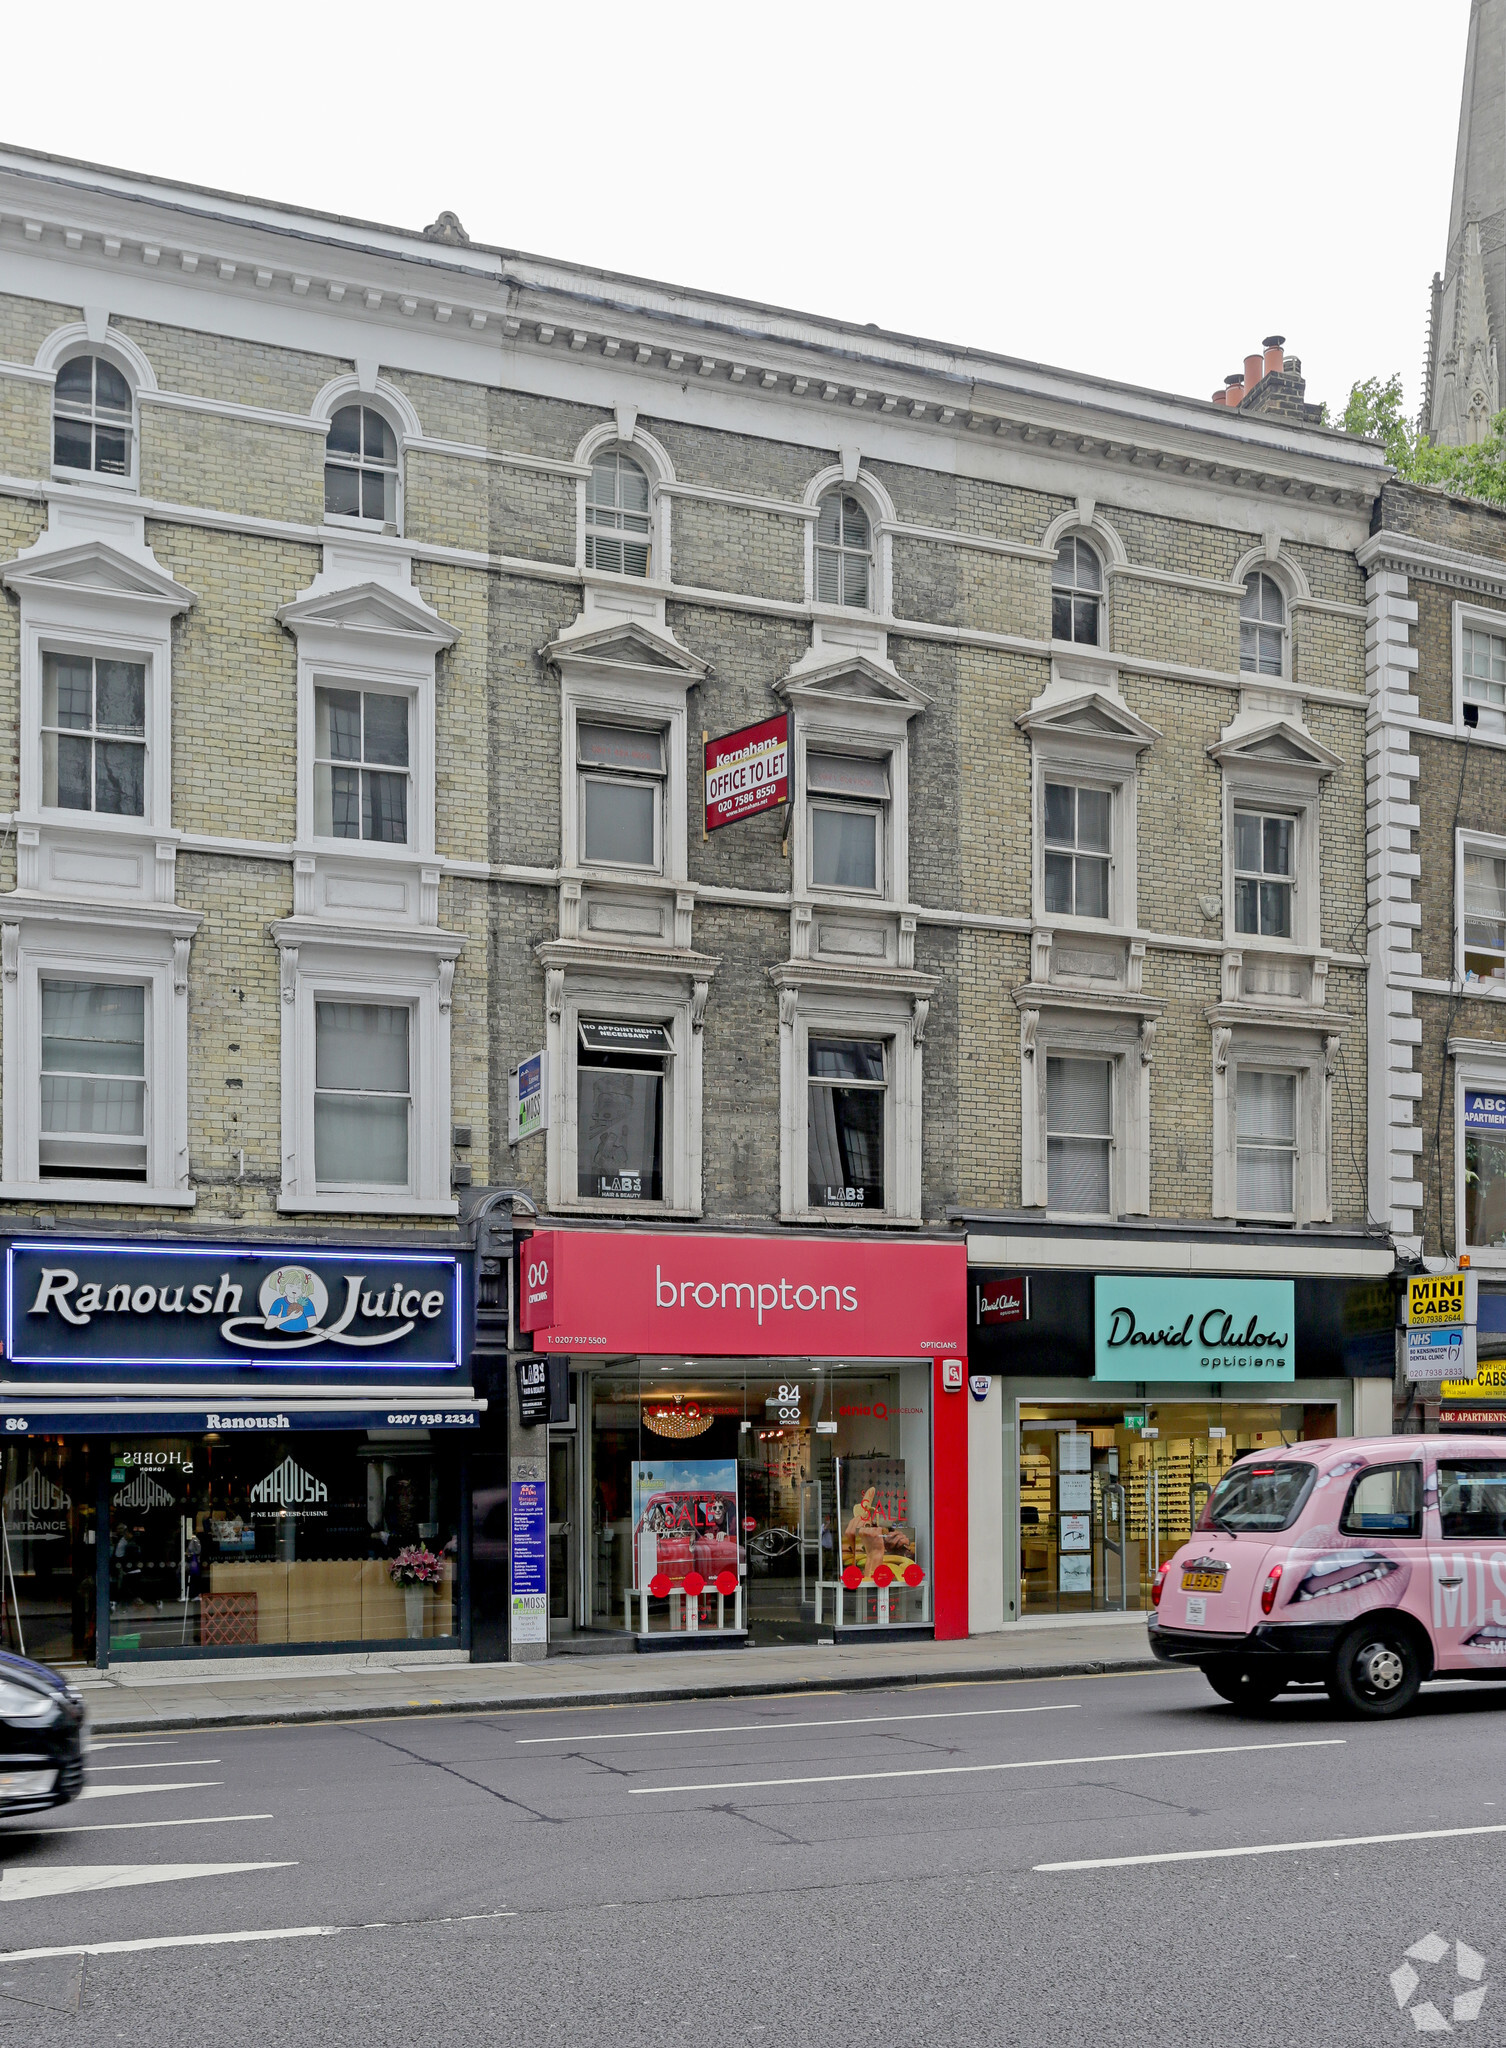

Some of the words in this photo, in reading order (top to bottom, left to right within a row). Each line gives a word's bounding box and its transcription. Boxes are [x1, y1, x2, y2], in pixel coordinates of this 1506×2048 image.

[716, 736, 778, 767] Kernahans
[710, 767, 746, 798] OFFICE
[749, 761, 763, 784] TO
[766, 752, 785, 778] LET
[718, 799, 732, 813] 020
[734, 791, 754, 806] 7586
[756, 783, 776, 800] 8550
[725, 798, 768, 818] www.kernahans.net
[597, 1025, 663, 1035] APPOINTMENTS
[599, 1030, 649, 1039] NECESSARY
[1472, 1097, 1506, 1112] ABC
[601, 1176, 632, 1192] LAB
[827, 1186, 856, 1200] LAB
[27, 1267, 243, 1325] Ranoush
[656, 1264, 858, 1326] bromptons
[1412, 1280, 1463, 1299] MINI
[1412, 1298, 1462, 1315] CABS
[1412, 1316, 1424, 1324] 020
[1426, 1315, 1443, 1323] 7938
[1444, 1314, 1461, 1322] 2644
[1107, 1306, 1194, 1348] David
[1199, 1308, 1288, 1348] Clulow
[547, 1335, 554, 1344] T.
[554, 1336, 573, 1344] 0207
[574, 1336, 587, 1344] 937
[588, 1336, 607, 1345] 5500
[920, 1341, 957, 1349] OPTICIANS
[1410, 1333, 1431, 1345] NHS
[1200, 1355, 1286, 1369] opticians
[1425, 1369, 1442, 1377] 7938
[1444, 1368, 1463, 1376] 2833
[1477, 1371, 1506, 1386] CABS
[778, 1384, 801, 1402] 84
[649, 1402, 683, 1416] etnia
[839, 1402, 871, 1416] etnia
[1440, 1412, 1456, 1421] ABC
[5, 1418, 28, 1431] 86
[206, 1414, 290, 1429] Ranoush
[387, 1414, 417, 1425] 0207
[419, 1413, 443, 1425] 938
[444, 1413, 474, 1425] 2234
[517, 1463, 539, 1479] 84
[250, 1455, 328, 1509] MAROUSH
[861, 1489, 909, 1498] SUMMER
[664, 1502, 717, 1529] SALE
[860, 1498, 909, 1522] SALE
[6, 1521, 67, 1531] ENTRANCE
[523, 1596, 546, 1609] MOSS
